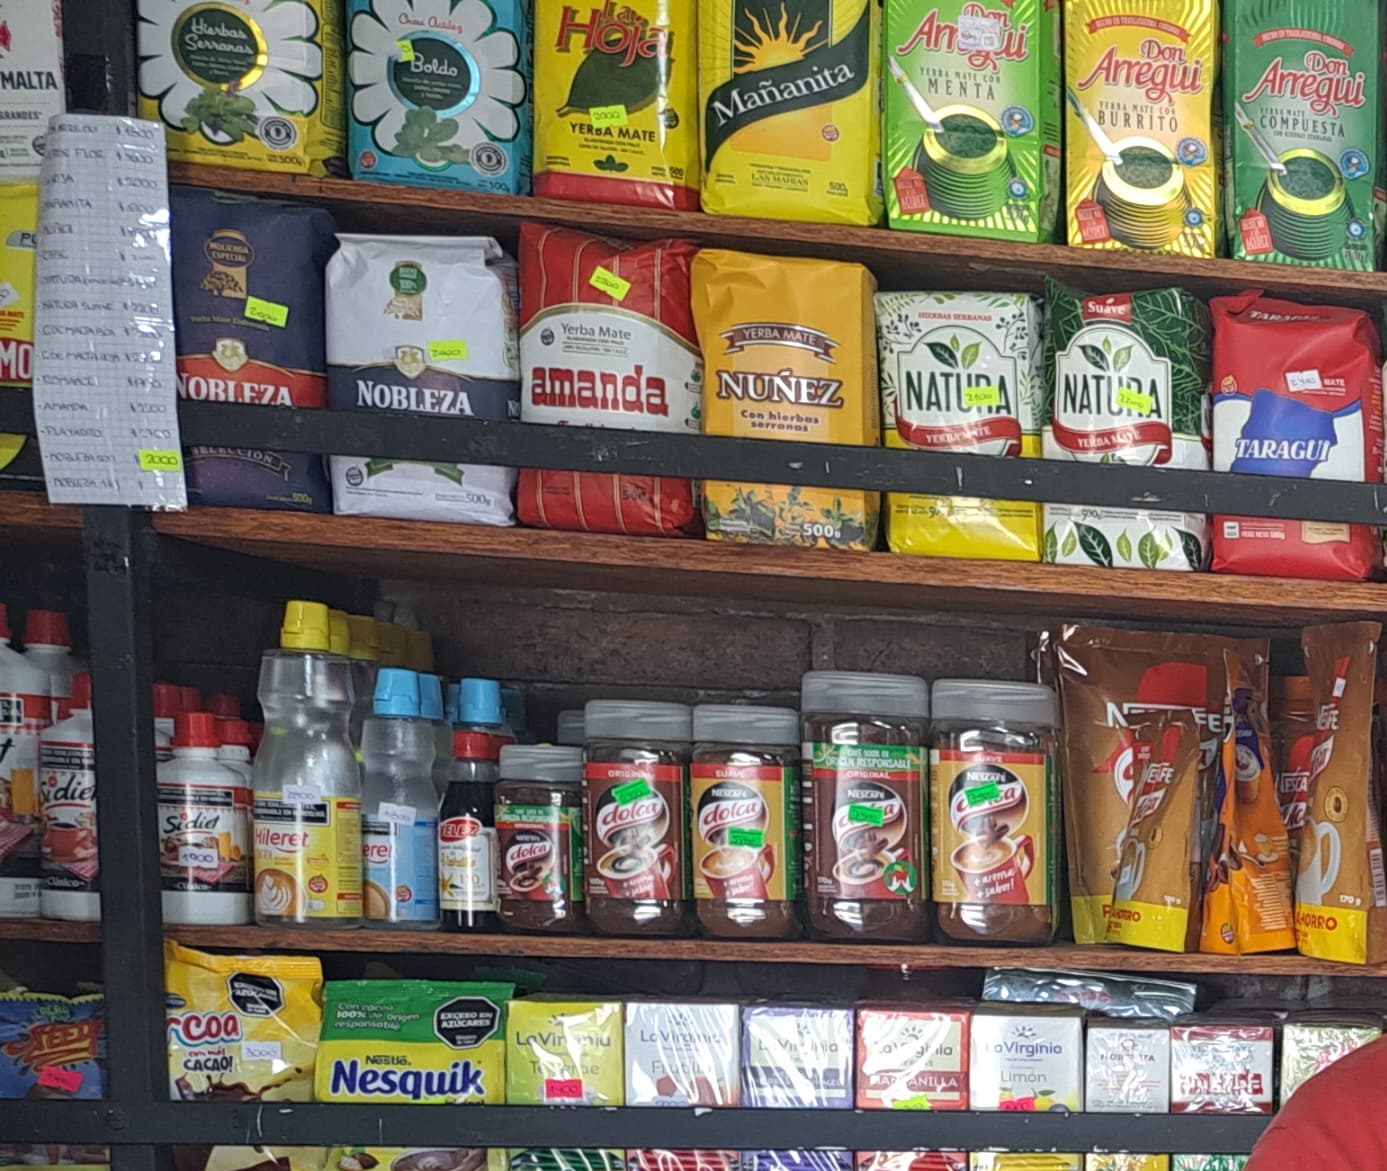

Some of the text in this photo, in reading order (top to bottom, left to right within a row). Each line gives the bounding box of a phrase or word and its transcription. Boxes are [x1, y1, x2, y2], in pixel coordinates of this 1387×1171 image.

[190, 19, 248, 41] Hierbas
[555, 4, 669, 67] Hoja
[184, 35, 254, 55] Serranas
[1141, 38, 1186, 64] Don
[410, 52, 459, 78] Boldo
[1304, 50, 1350, 77] Don
[1078, 46, 1204, 105] Arregui
[711, 60, 856, 127] Mañanita
[927, 80, 998, 102] MENTA
[1242, 58, 1367, 118] Arregui
[1097, 110, 1180, 133] BURRITO
[1259, 115, 1347, 139] COMPUESTA
[624, 127, 657, 144] MATE
[1087, 301, 1127, 316] Suave
[560, 321, 633, 341] Yerba Mate
[742, 327, 817, 347] YERBA MATE
[175, 371, 291, 406] NOBLEZA
[356, 378, 472, 417] NOBLEZA
[530, 364, 670, 419] amanda
[715, 367, 845, 410] NUÑEZ
[740, 408, 820, 425] Con hierbas
[750, 421, 810, 434] serranas
[802, 522, 842, 540] 500g
[715, 767, 747, 779] SUAVE
[164, 813, 219, 834] Sidiet
[599, 801, 661, 830] dolca
[702, 800, 762, 830] dolca
[255, 826, 310, 849] Hileret
[508, 842, 551, 863] dolca
[182, 1054, 234, 1075] CACAO!
[330, 1061, 486, 1102] Nesquik
[999, 1069, 1048, 1086] Limón
